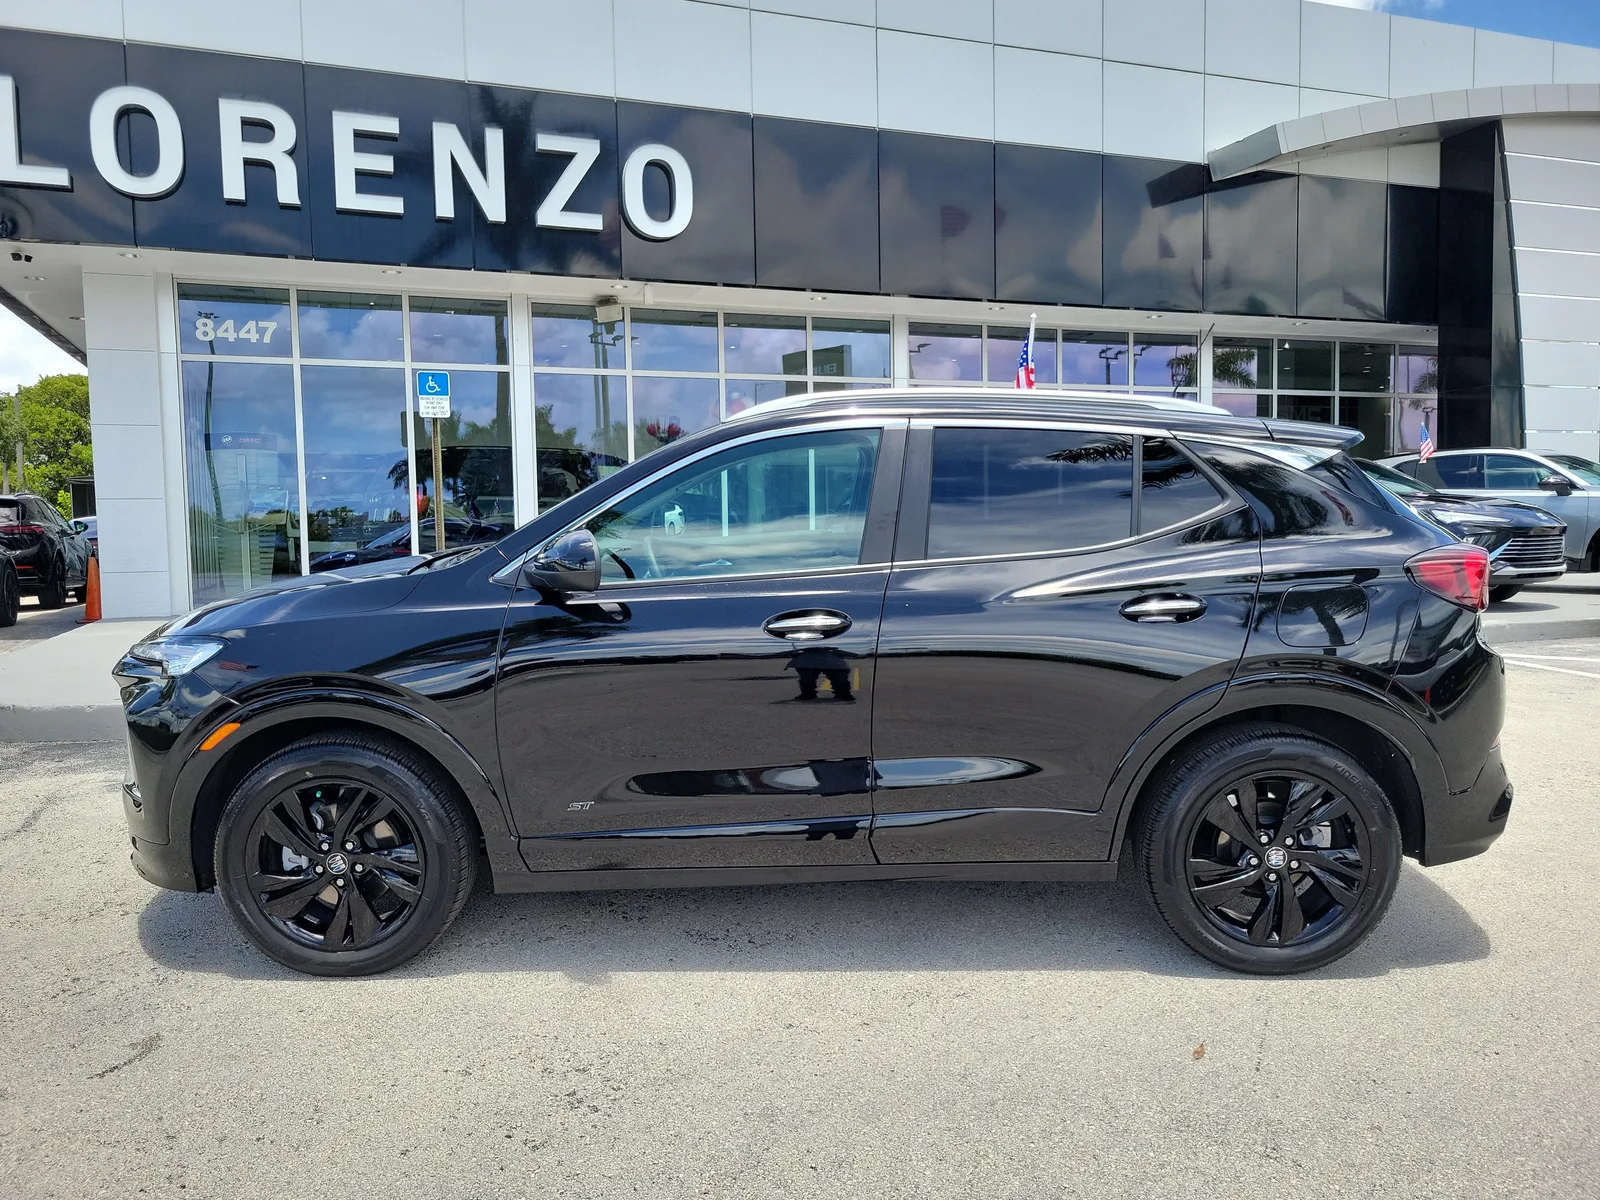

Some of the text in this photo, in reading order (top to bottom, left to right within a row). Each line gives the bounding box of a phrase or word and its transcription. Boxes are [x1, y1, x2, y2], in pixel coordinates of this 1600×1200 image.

[0, 74, 693, 239] LORENZO
[195, 318, 277, 343] 8447
[567, 801, 595, 811] ST
